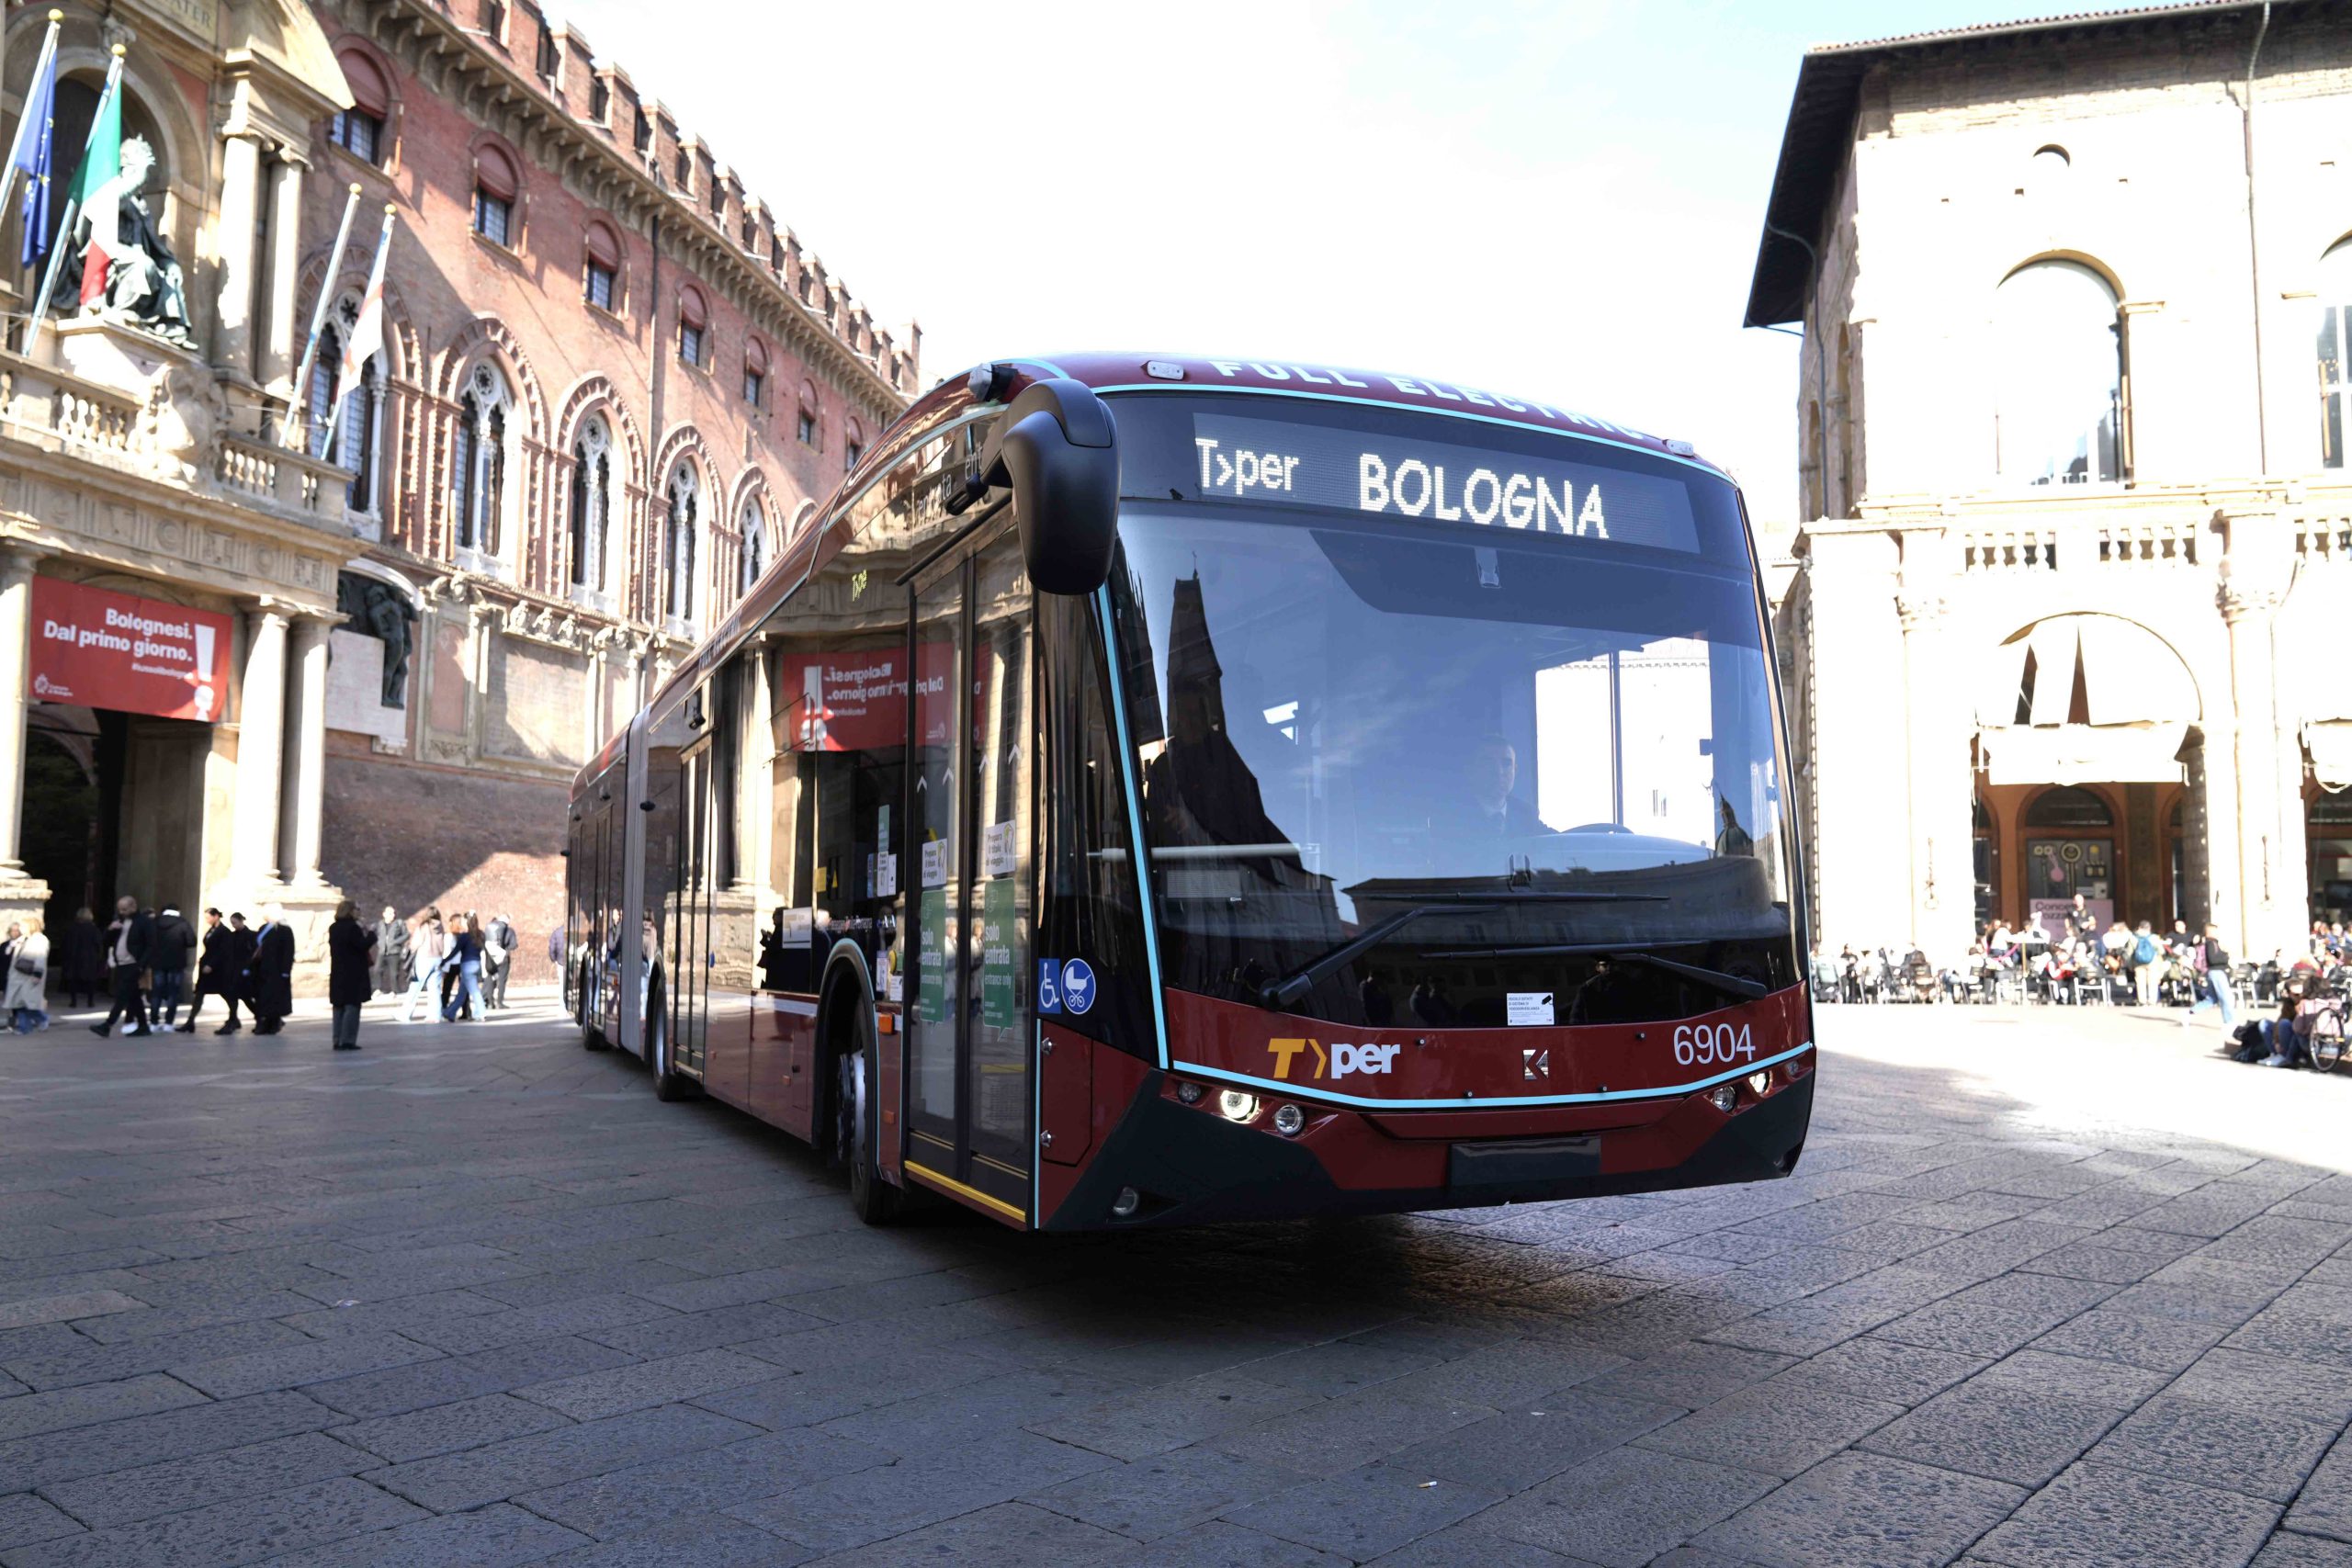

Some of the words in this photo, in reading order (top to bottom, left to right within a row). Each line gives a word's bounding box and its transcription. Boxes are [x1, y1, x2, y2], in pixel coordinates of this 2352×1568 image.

[1208, 360, 1369, 389] FULL
[1360, 453, 1610, 539] BOLOGNA
[106, 607, 193, 640] Bolognesi.
[44, 620, 77, 642] Dal
[79, 629, 131, 651] primo
[133, 637, 193, 662] giorno.
[922, 927, 933, 945] solo
[985, 921, 1000, 942] solo
[922, 948, 942, 967] entrata
[985, 944, 1010, 965] entrata
[1673, 1023, 1756, 1066] 6904
